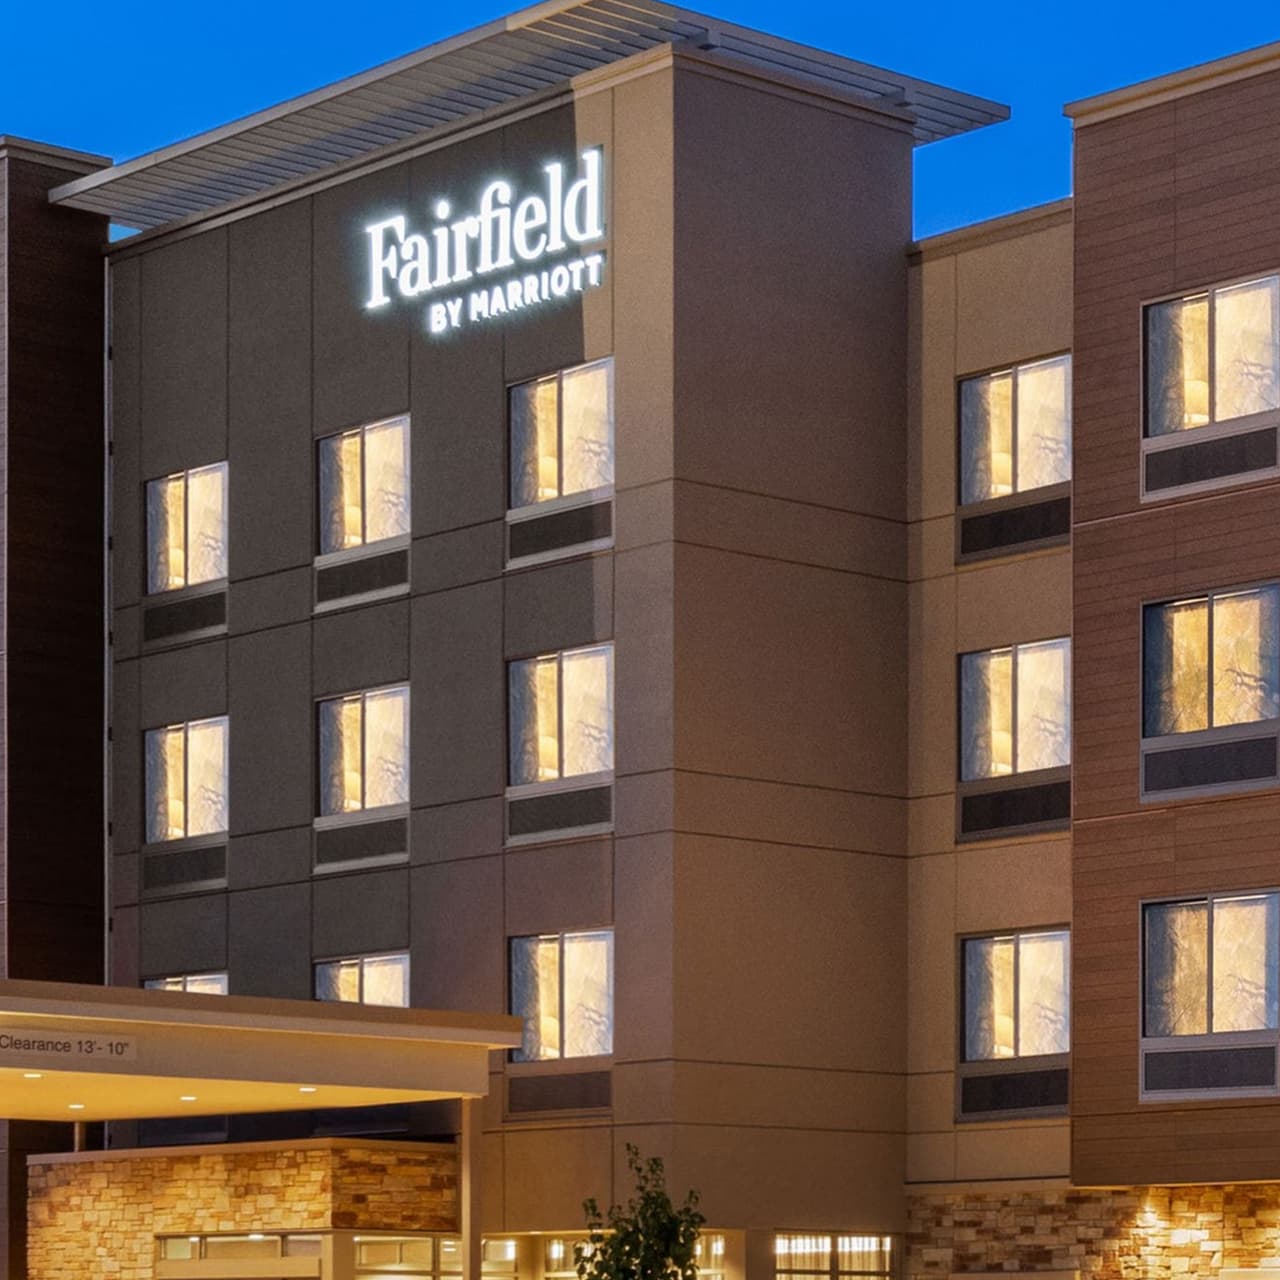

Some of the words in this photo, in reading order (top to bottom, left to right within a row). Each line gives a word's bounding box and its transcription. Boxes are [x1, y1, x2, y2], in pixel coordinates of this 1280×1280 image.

[365, 148, 604, 310] Fairfield
[429, 297, 464, 333] BY
[469, 253, 604, 323] MARRIOTT
